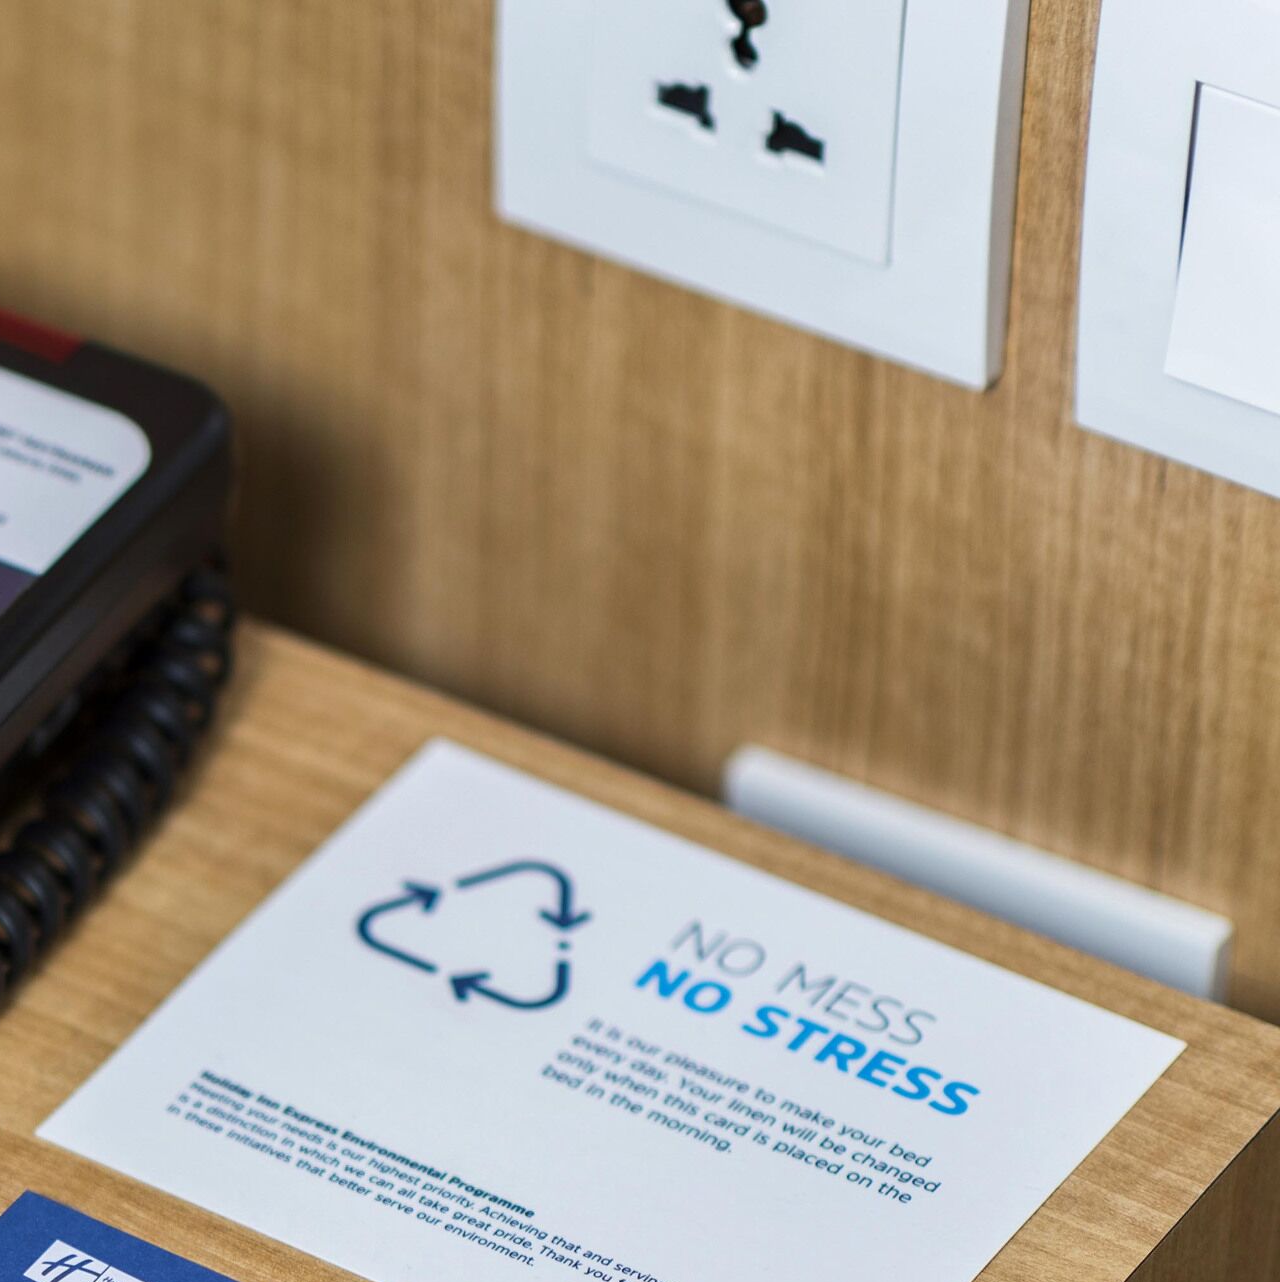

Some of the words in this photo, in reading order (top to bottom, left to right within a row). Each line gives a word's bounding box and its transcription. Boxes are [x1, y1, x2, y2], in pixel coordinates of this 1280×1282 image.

[635, 960, 732, 1014] NO
[741, 1005, 981, 1116] STRESS
[672, 921, 767, 977] NO
[777, 963, 937, 1046] MESS
[200, 1071, 253, 1099] Holiday
[256, 1095, 280, 1110] Inn
[282, 1105, 339, 1135] Express
[341, 1130, 448, 1181] Environmental
[447, 1176, 535, 1218] Programme
[541, 1064, 584, 1089] bed
[585, 1083, 606, 1099] in
[609, 1093, 643, 1114] the
[647, 1110, 731, 1153] morning.
[556, 1051, 598, 1075] only
[604, 1070, 659, 1100] when
[663, 1093, 697, 1116] this
[703, 1113, 751, 1137] card
[752, 1131, 768, 1145] is
[772, 1141, 844, 1175] placed
[846, 1172, 873, 1188] on
[877, 1182, 912, 1204] the
[572, 1036, 626, 1065] every
[630, 1061, 670, 1084] day.
[680, 1076, 723, 1103] Your
[727, 1098, 777, 1126] linen
[782, 1122, 817, 1142] will
[819, 1136, 847, 1155] be
[851, 1152, 942, 1193] changed
[587, 1018, 604, 1033] It
[605, 1027, 622, 1041] is
[626, 1038, 661, 1056] our
[663, 1053, 750, 1093] pleasure
[754, 1088, 776, 1104] to
[779, 1100, 835, 1127] make
[838, 1125, 884, 1148] your
[889, 1143, 932, 1168] bed
[184, 1112, 224, 1133] these
[226, 1129, 292, 1163] initiatives
[295, 1159, 326, 1177] that
[328, 1172, 372, 1196] better
[374, 1194, 414, 1214] serve
[416, 1212, 442, 1225] our
[444, 1223, 534, 1267] environment.
[189, 1081, 245, 1112] Meeting
[246, 1107, 279, 1125] your
[280, 1122, 324, 1145] needs
[340, 1148, 366, 1162] our
[367, 1157, 421, 1186] highest
[421, 1182, 475, 1209] priority.
[479, 1206, 548, 1241] Achieving
[551, 1235, 582, 1254] that
[582, 1250, 614, 1266] and
[205, 1106, 278, 1141] distinction
[298, 1145, 340, 1167] which
[368, 1175, 395, 1191] can
[397, 1188, 417, 1199] all
[418, 1195, 450, 1214] take
[452, 1211, 492, 1232] great
[493, 1228, 533, 1250] pride.
[540, 1245, 582, 1270] Thank
[583, 1267, 613, 1282] you
